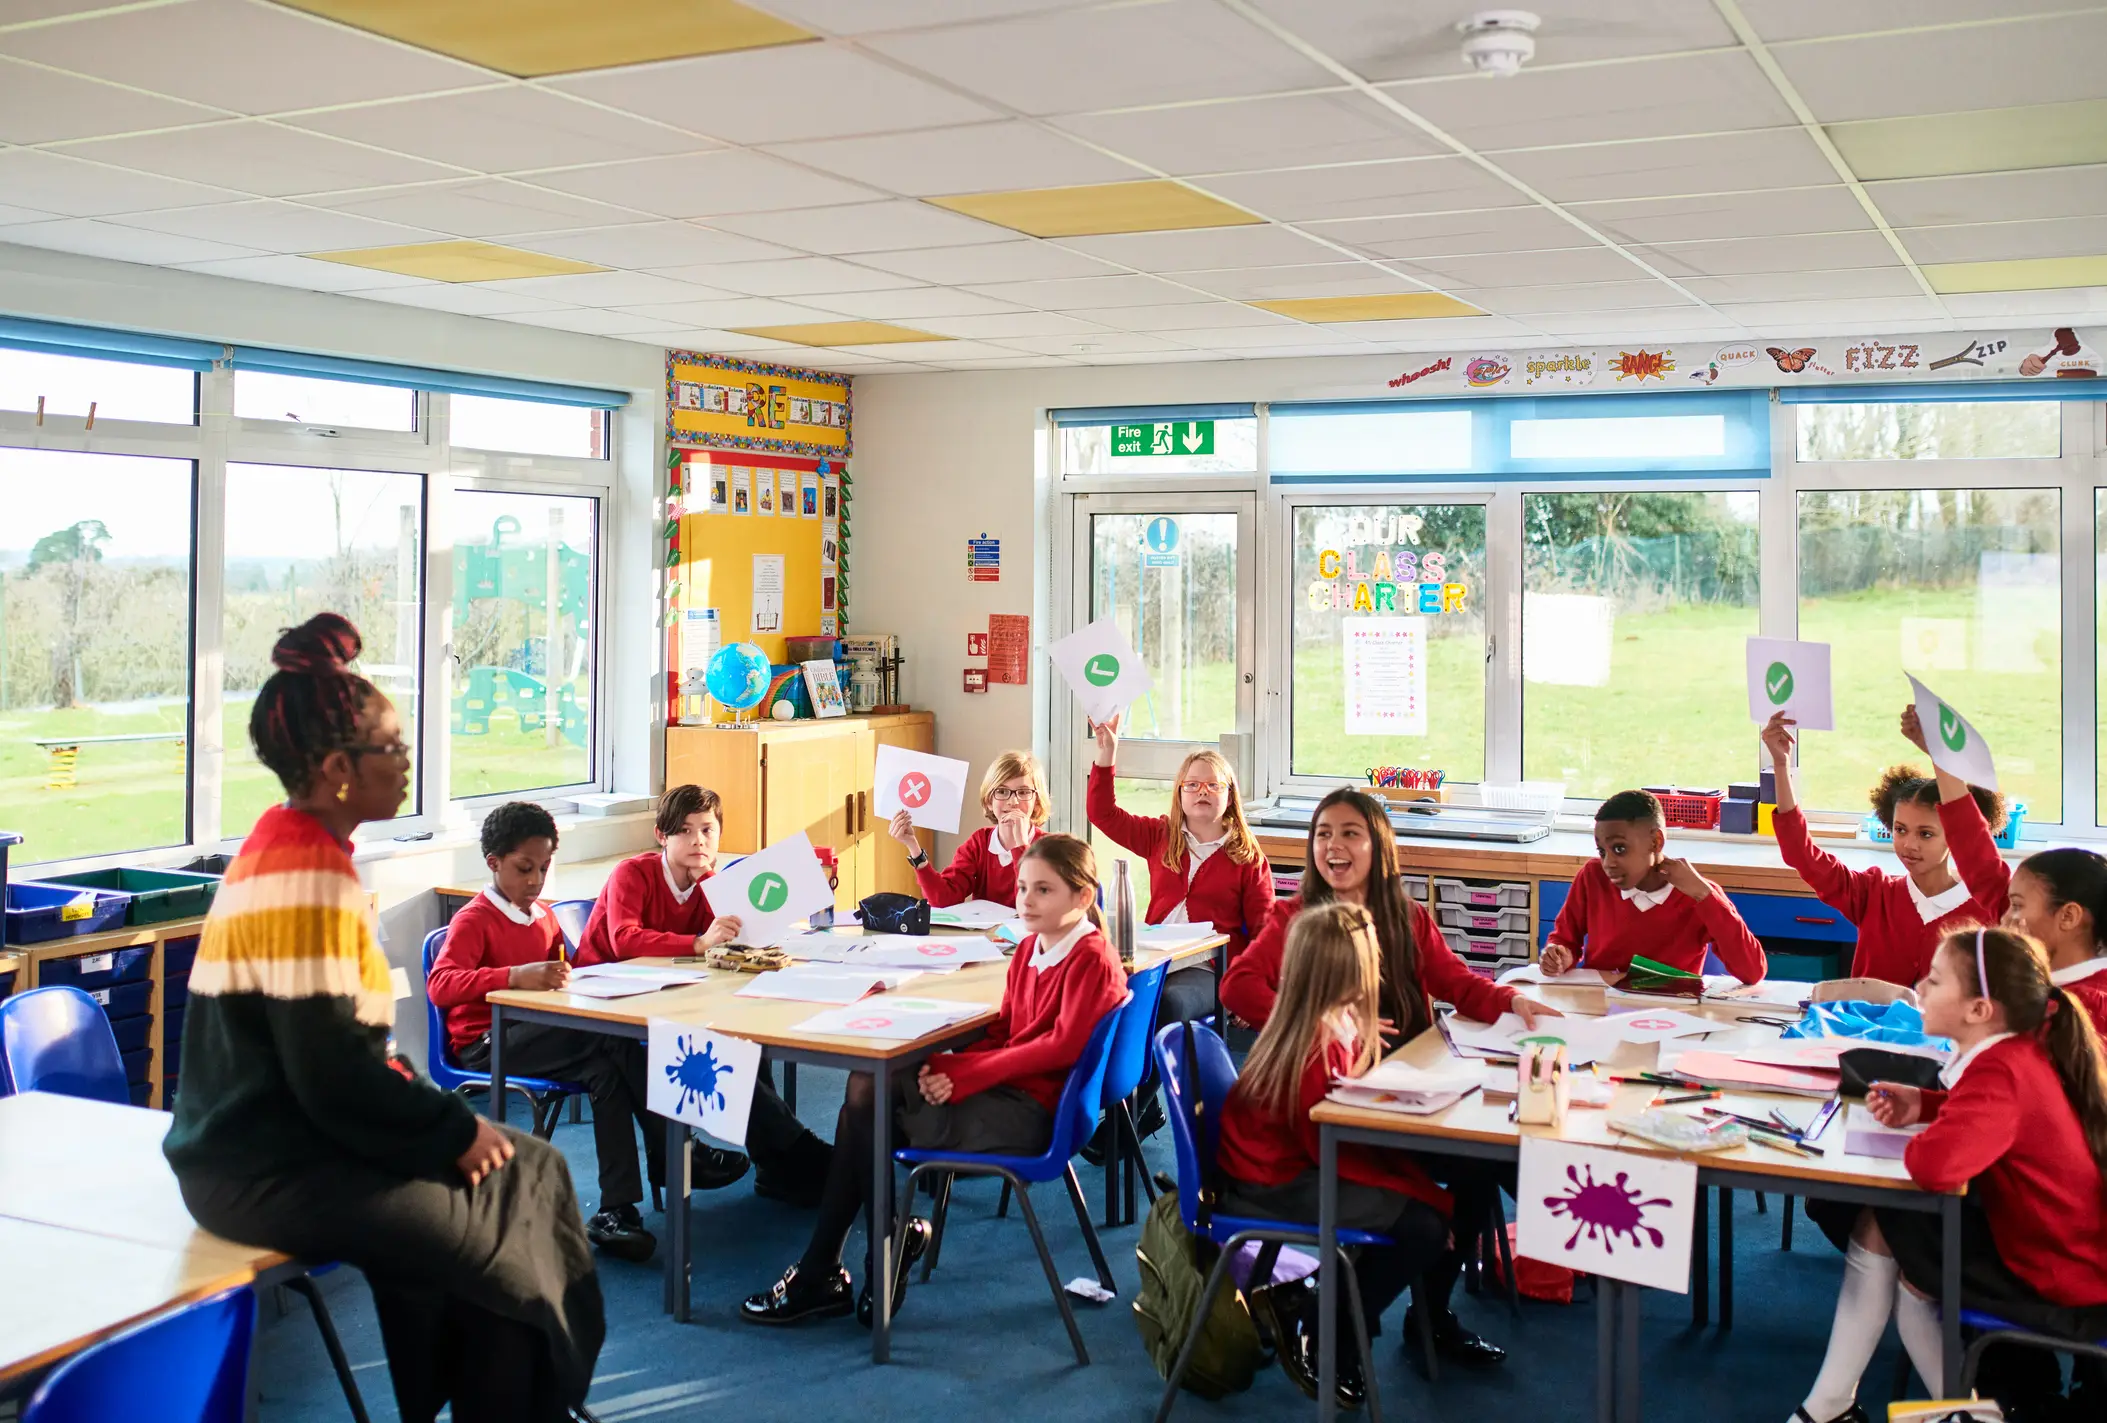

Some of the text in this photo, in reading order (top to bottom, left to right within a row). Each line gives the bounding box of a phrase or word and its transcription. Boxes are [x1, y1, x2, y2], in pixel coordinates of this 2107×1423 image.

[1720, 351, 1756, 362] QUACK
[1845, 344, 1920, 371] FIZZ
[1976, 339, 2008, 358] ZIP
[1388, 356, 1452, 389] whoosh!
[1526, 356, 1592, 378] sparkle
[1807, 361, 1836, 376] flutter
[2060, 360, 2091, 368] CLUNK
[746, 382, 787, 429] RE
[1118, 426, 1141, 438] Fire
[1118, 441, 1141, 453] exit
[1350, 515, 1423, 545] OUR
[1319, 550, 1445, 583] CLASS
[1308, 581, 1468, 614] CHARTER
[812, 672, 834, 681] BIBLE
